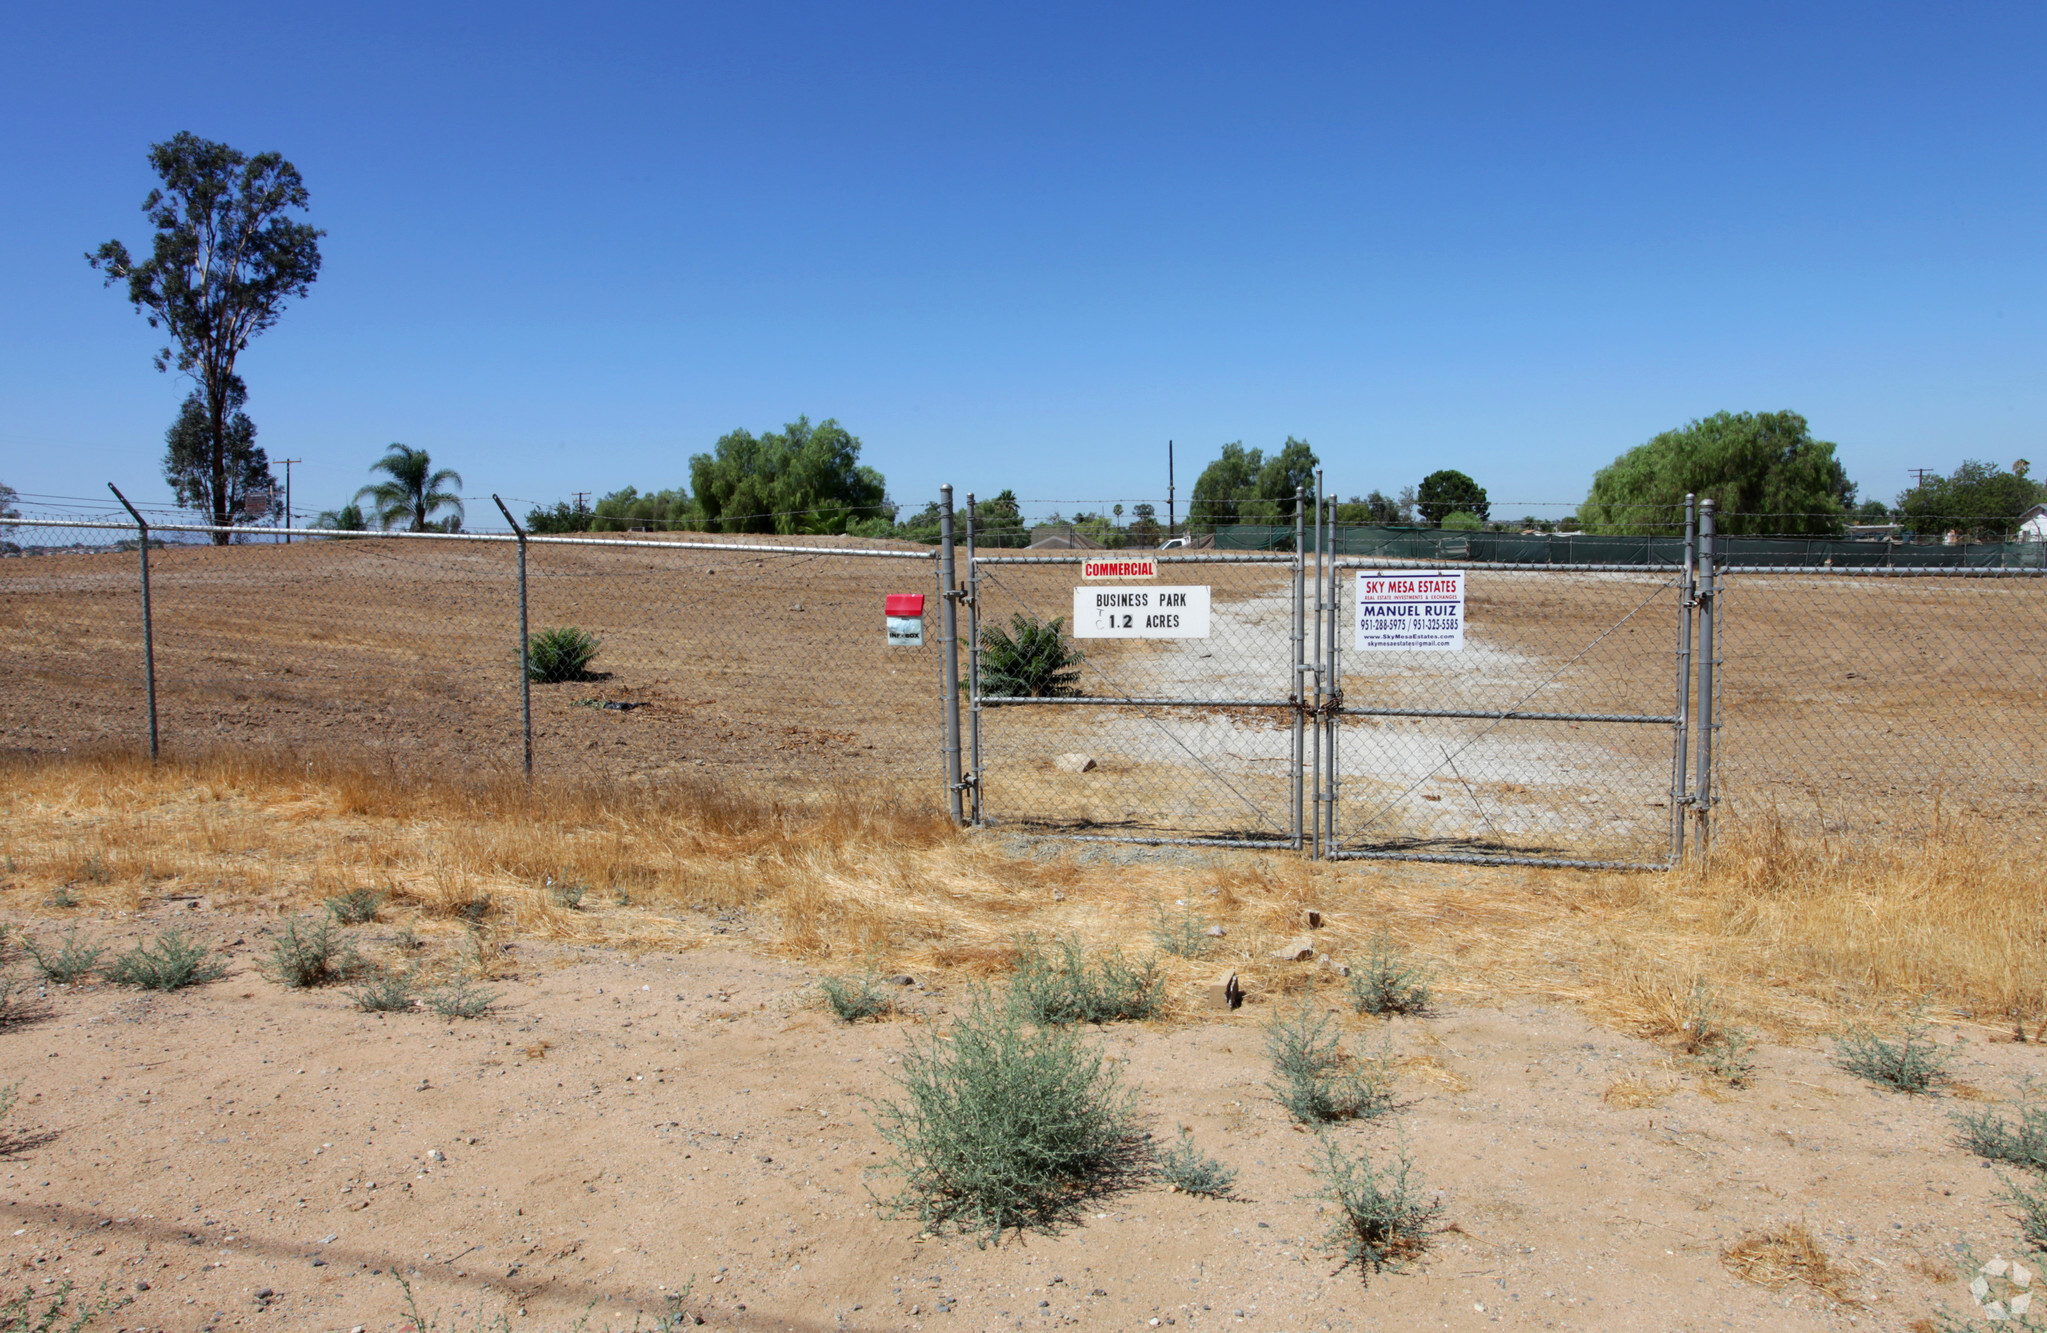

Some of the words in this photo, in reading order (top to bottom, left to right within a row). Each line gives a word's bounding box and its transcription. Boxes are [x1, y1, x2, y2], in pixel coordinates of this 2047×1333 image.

[1086, 563, 1153, 576] COMMERCIAL
[1366, 581, 1385, 593] SKY
[1388, 581, 1415, 593] MESA
[1418, 581, 1456, 592] ESTATES
[1097, 594, 1148, 607] BUSINESS
[1160, 593, 1186, 606] PARK
[1364, 606, 1420, 616] MANUEL
[1425, 605, 1456, 616] RUIZ
[1110, 615, 1132, 628] 1.2
[1146, 615, 1179, 628] ACRES
[1361, 619, 1405, 630] 951-288-5975
[1413, 619, 1458, 630] 951-325-5585
